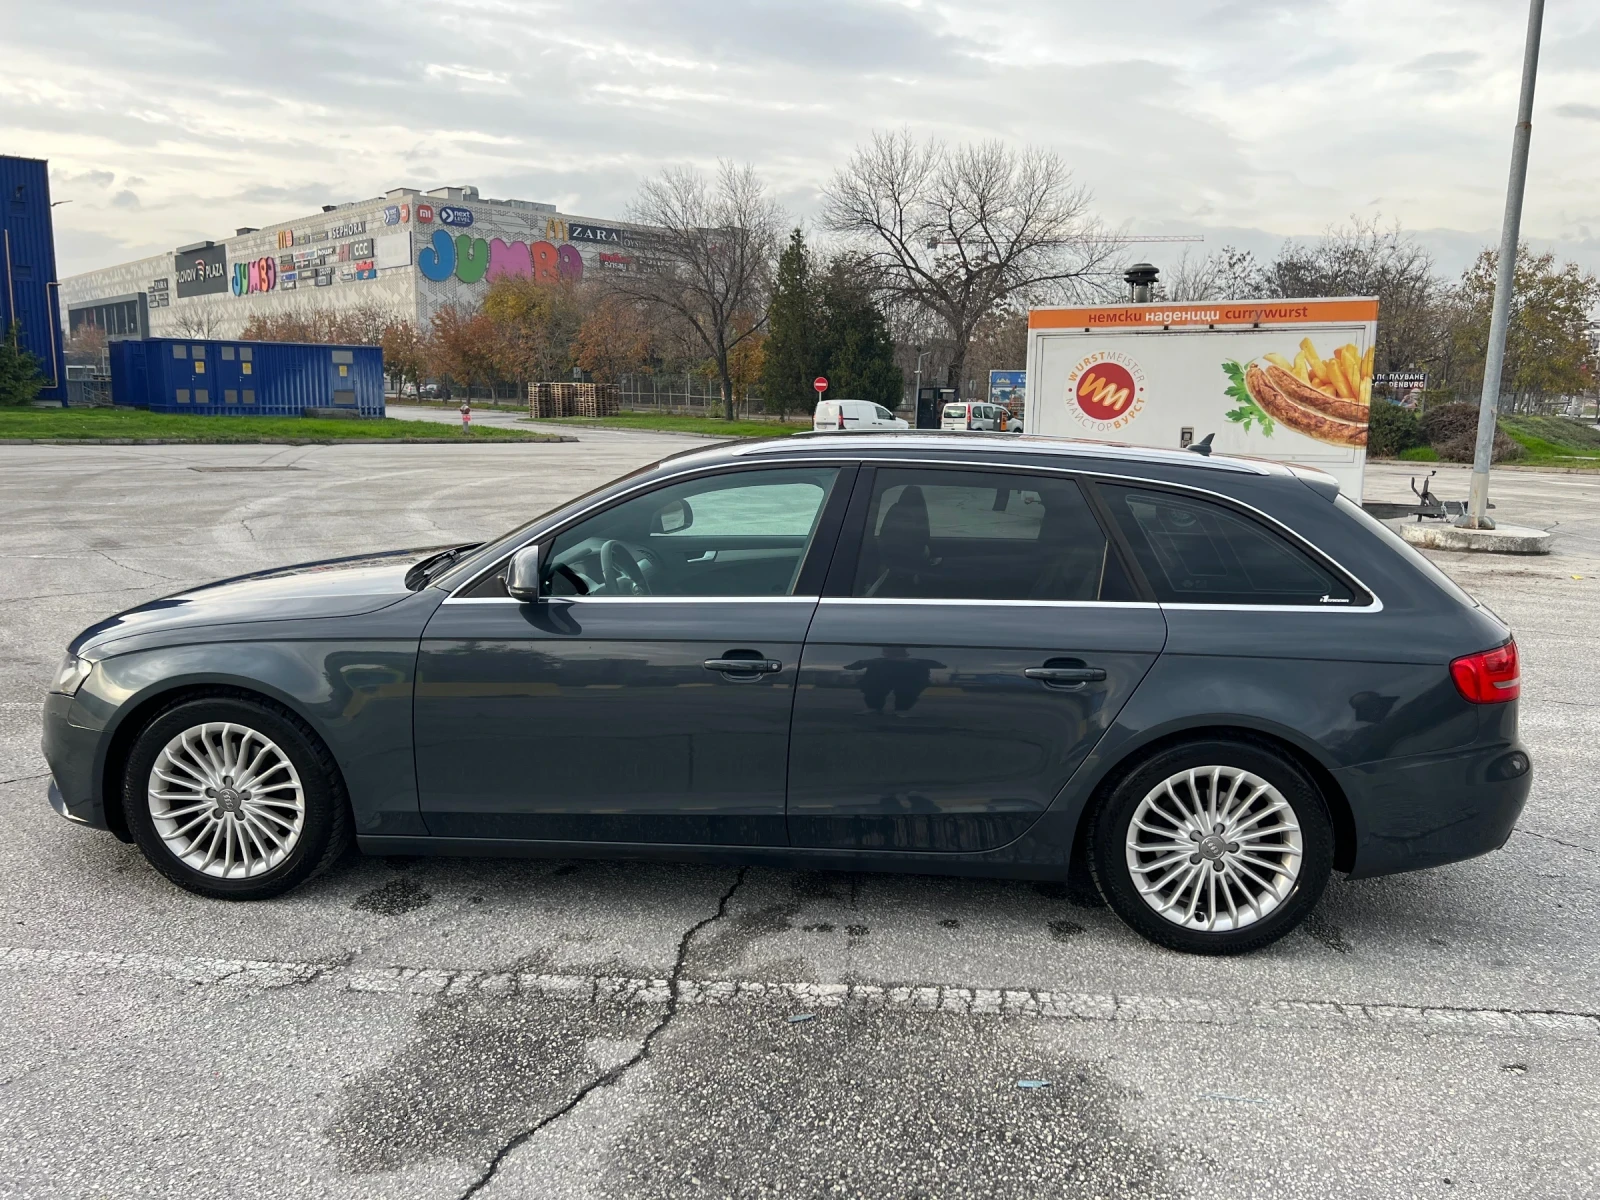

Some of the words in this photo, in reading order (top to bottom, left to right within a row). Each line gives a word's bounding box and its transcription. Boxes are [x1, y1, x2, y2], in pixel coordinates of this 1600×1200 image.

[454, 210, 471, 218] next
[332, 222, 363, 239] SEPHORA
[572, 226, 618, 242] ZARA
[354, 242, 368, 256] CCC
[417, 228, 583, 285] JUMBO
[206, 263, 224, 279] PLAZA
[232, 256, 276, 297] JUMBO
[1088, 309, 1142, 323] немски
[1145, 310, 1219, 325] наденици
[1225, 306, 1308, 321] currywurst
